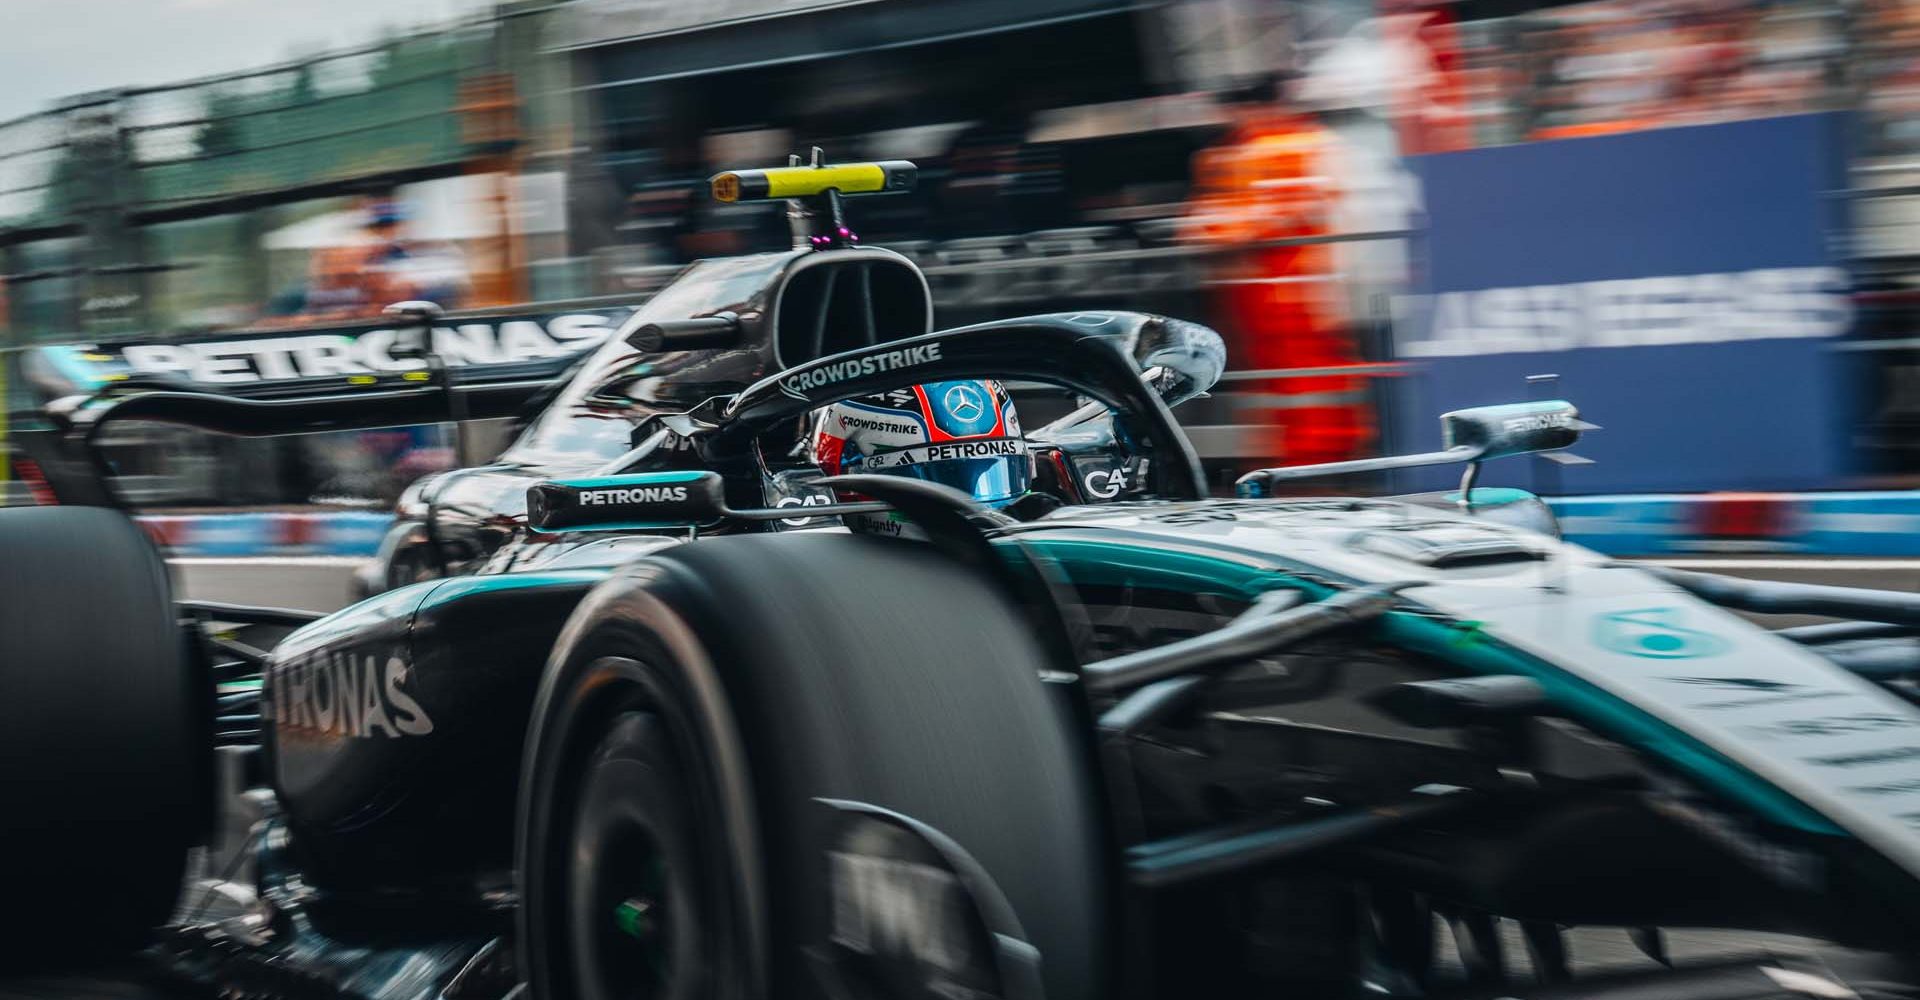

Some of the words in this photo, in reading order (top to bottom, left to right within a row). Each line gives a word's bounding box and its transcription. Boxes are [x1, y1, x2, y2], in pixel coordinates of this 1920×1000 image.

[787, 342, 943, 392] CROWDSTRIKE
[842, 415, 918, 435] CROWDSTRIKE
[927, 441, 1017, 461] PETRONAS
[579, 486, 688, 506] PETRONAS
